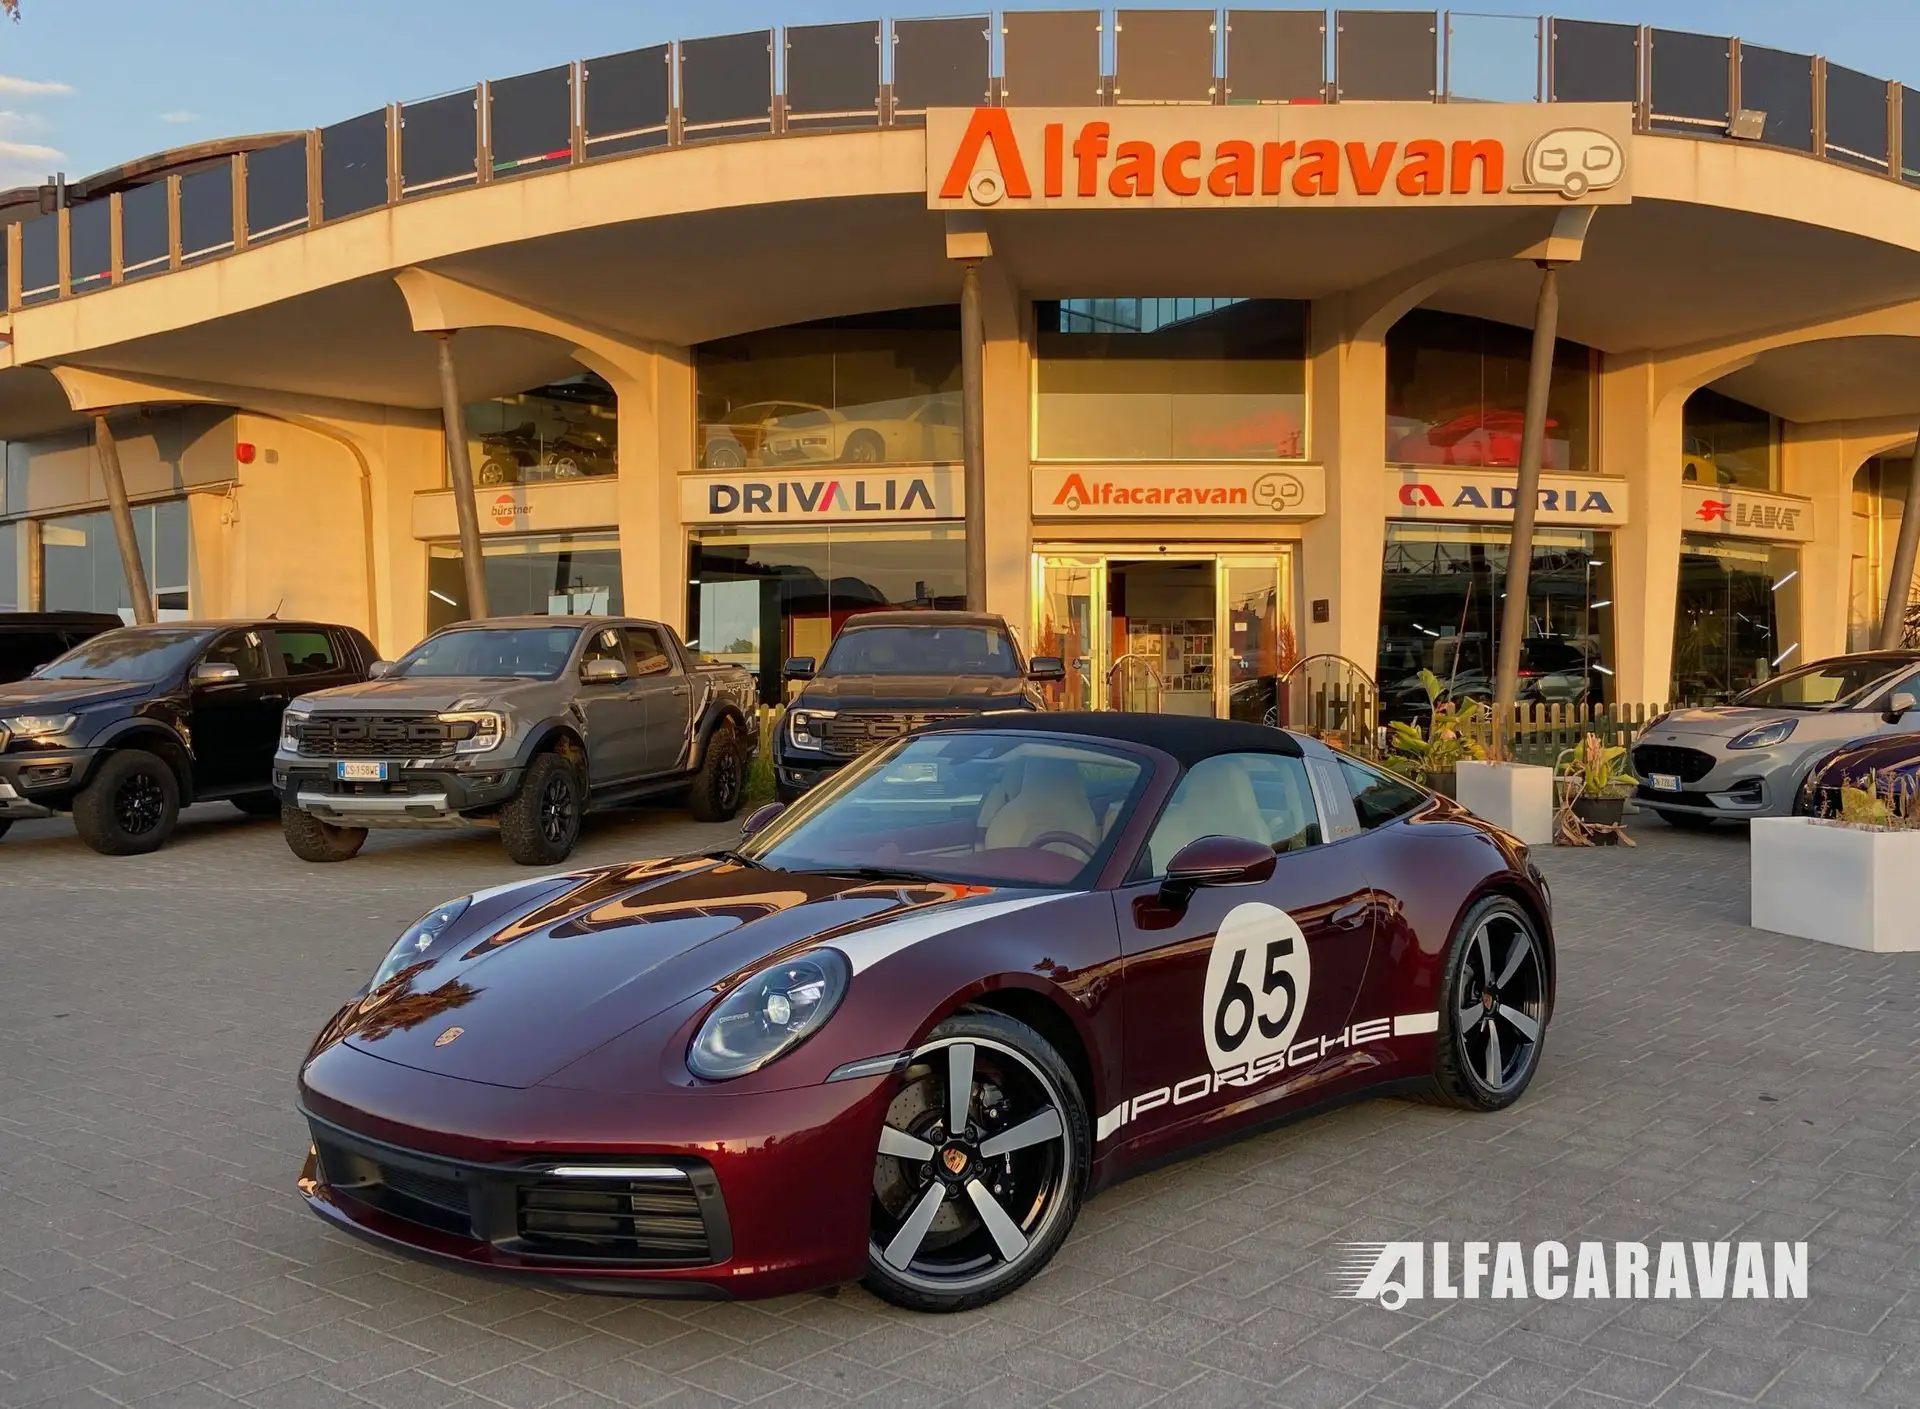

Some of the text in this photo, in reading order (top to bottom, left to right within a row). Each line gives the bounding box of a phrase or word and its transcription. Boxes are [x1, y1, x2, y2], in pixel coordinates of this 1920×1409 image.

[938, 107, 1505, 200] Alfacaravan
[708, 479, 936, 514] DRIVALIA
[1052, 473, 1247, 506] Alfacaravan
[1451, 485, 1614, 514] ADRIA
[491, 505, 533, 516] bürstner
[1735, 502, 1802, 532] LAIKA
[1214, 937, 1297, 1053] 65
[1130, 1017, 1391, 1122] PORSCHE
